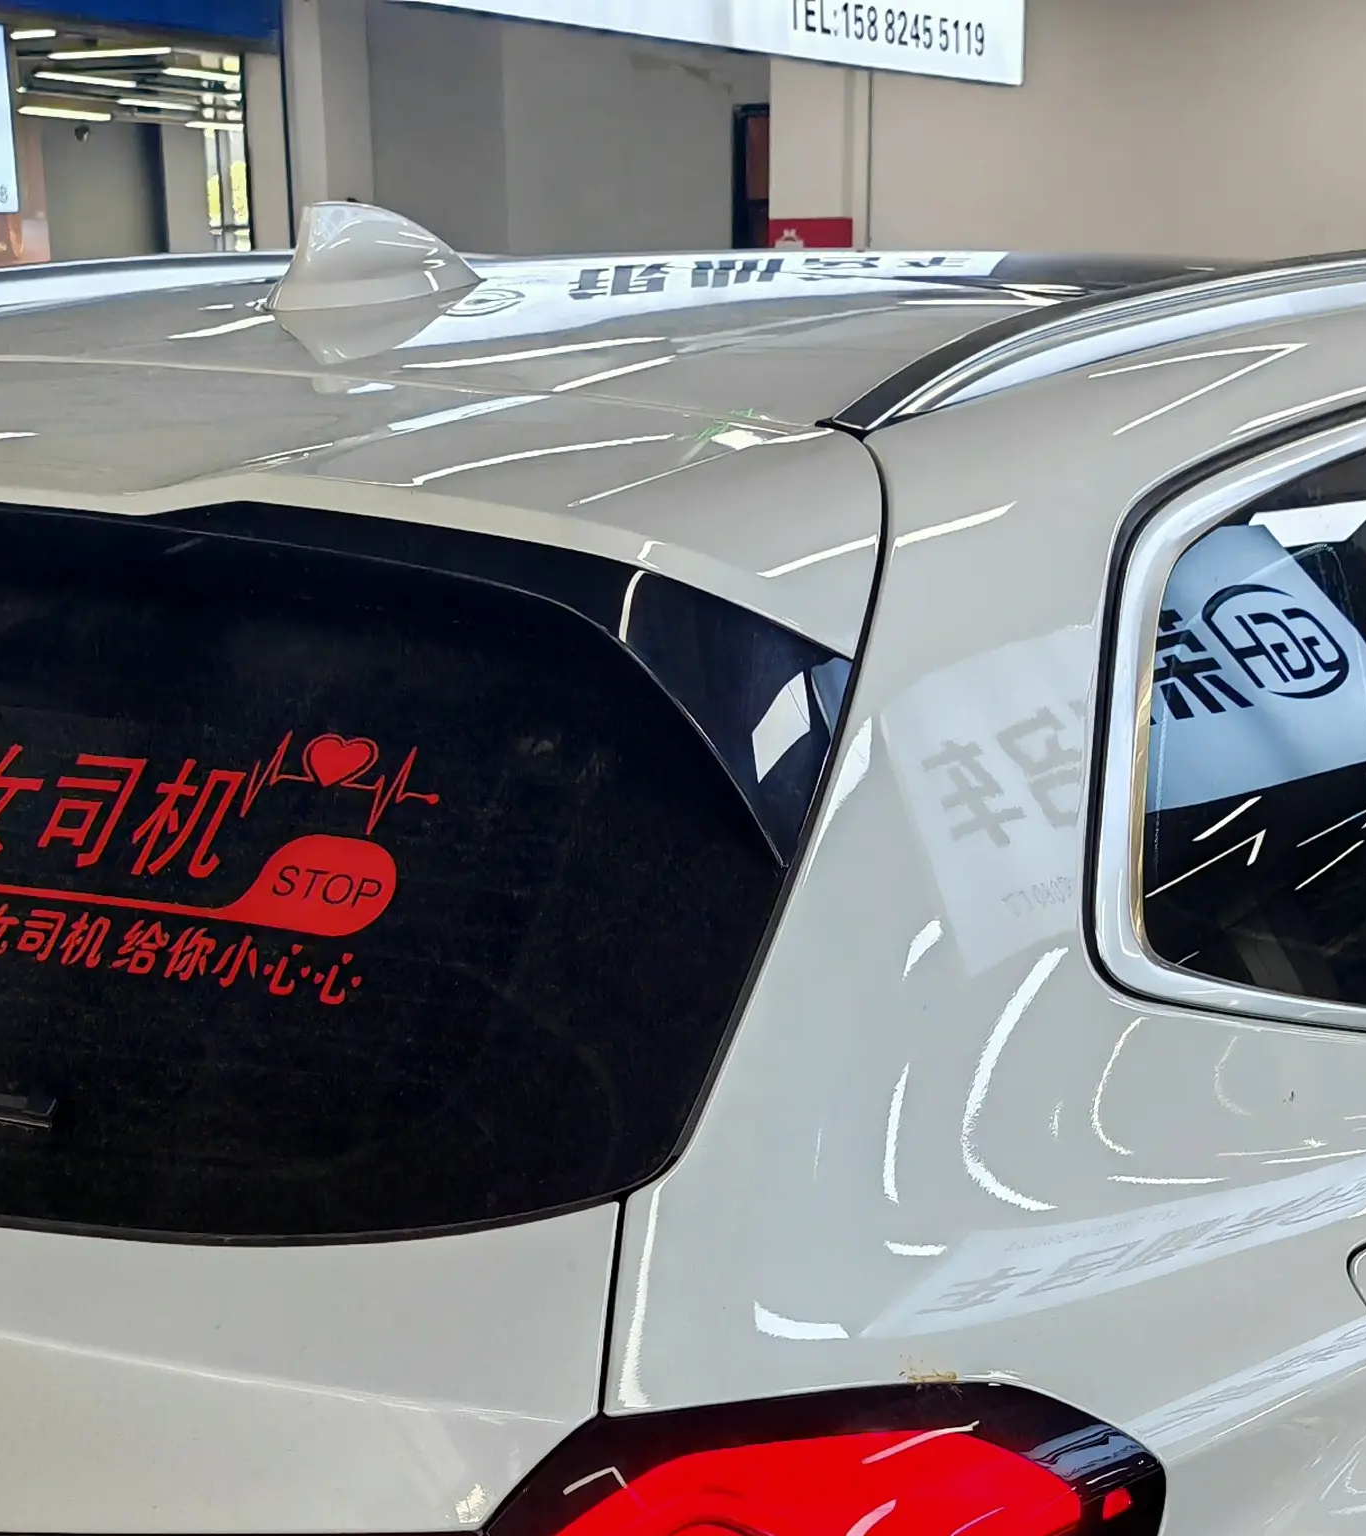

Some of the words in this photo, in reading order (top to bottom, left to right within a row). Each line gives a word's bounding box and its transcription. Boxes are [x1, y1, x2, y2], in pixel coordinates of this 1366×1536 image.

[884, 9, 933, 50] 8245
[939, 18, 985, 57] 5119
[271, 866, 383, 910] STOP
[112, 919, 363, 1006] 给你小心心
